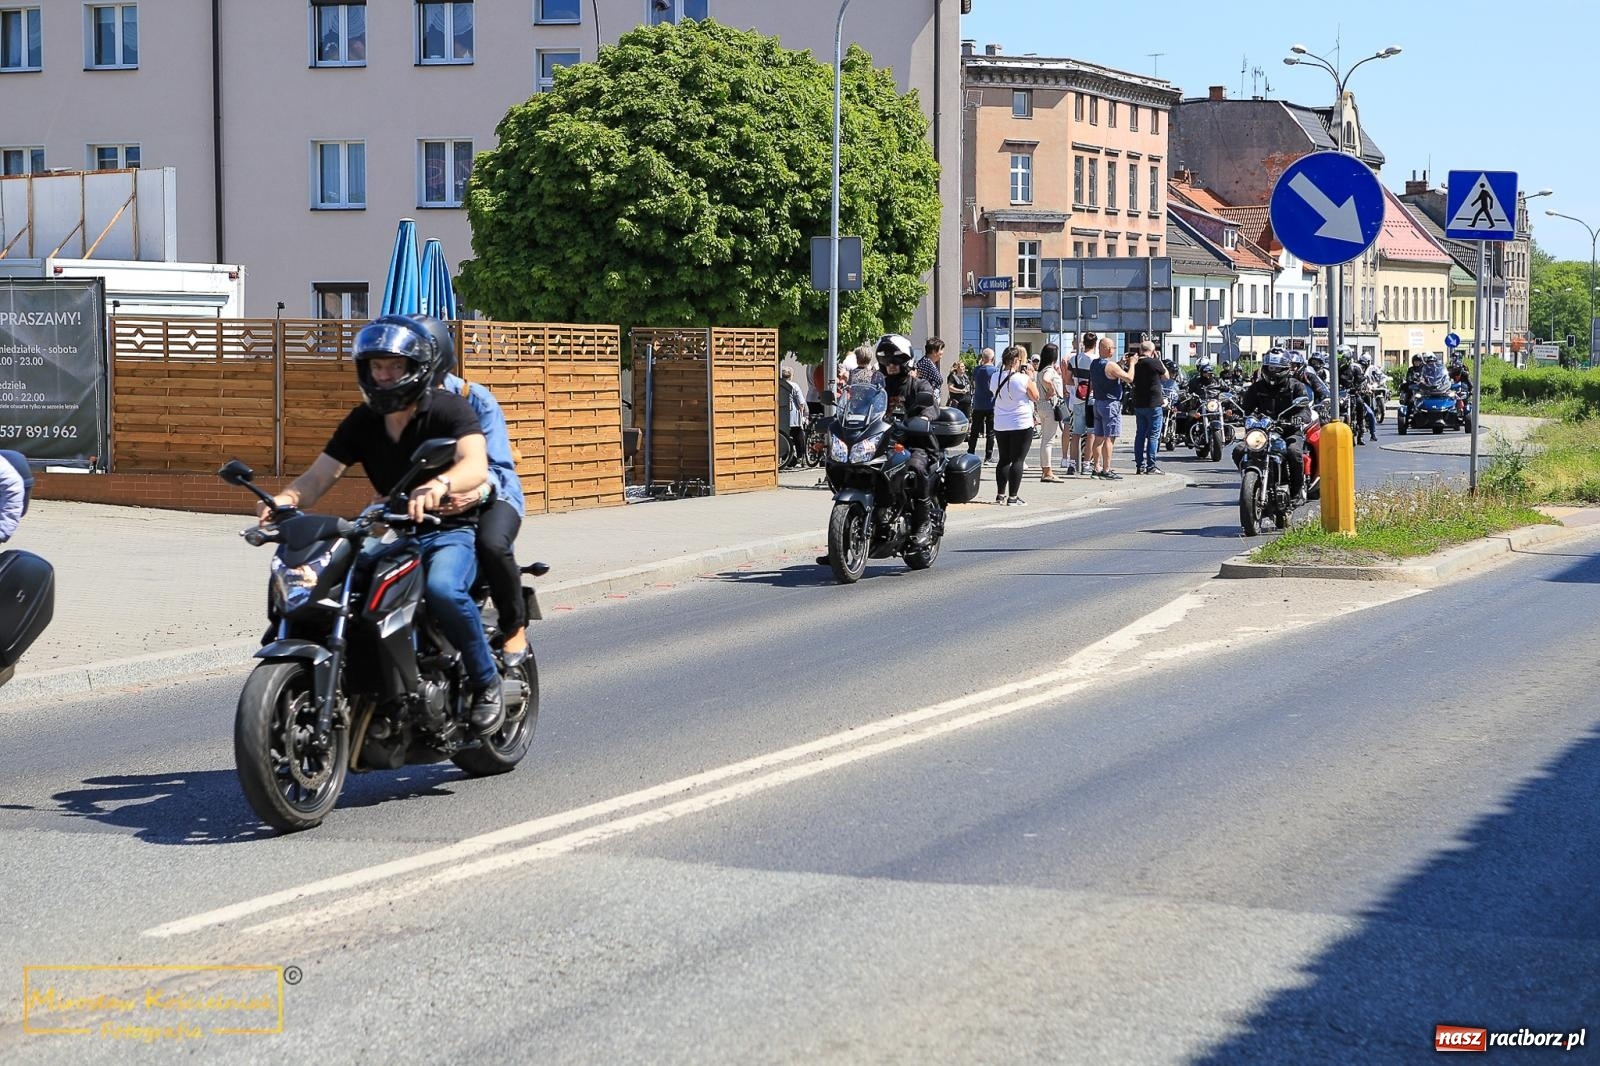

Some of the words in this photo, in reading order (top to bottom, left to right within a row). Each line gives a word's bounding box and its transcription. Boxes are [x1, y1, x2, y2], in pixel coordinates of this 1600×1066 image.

[0, 312, 81, 325] PRASZAMY!
[48, 344, 77, 354] sobota
[20, 356, 44, 366] 23.00
[21, 392, 45, 402] 22.00
[0, 425, 22, 438] 537
[26, 425, 49, 438] 891
[53, 425, 77, 438] 962
